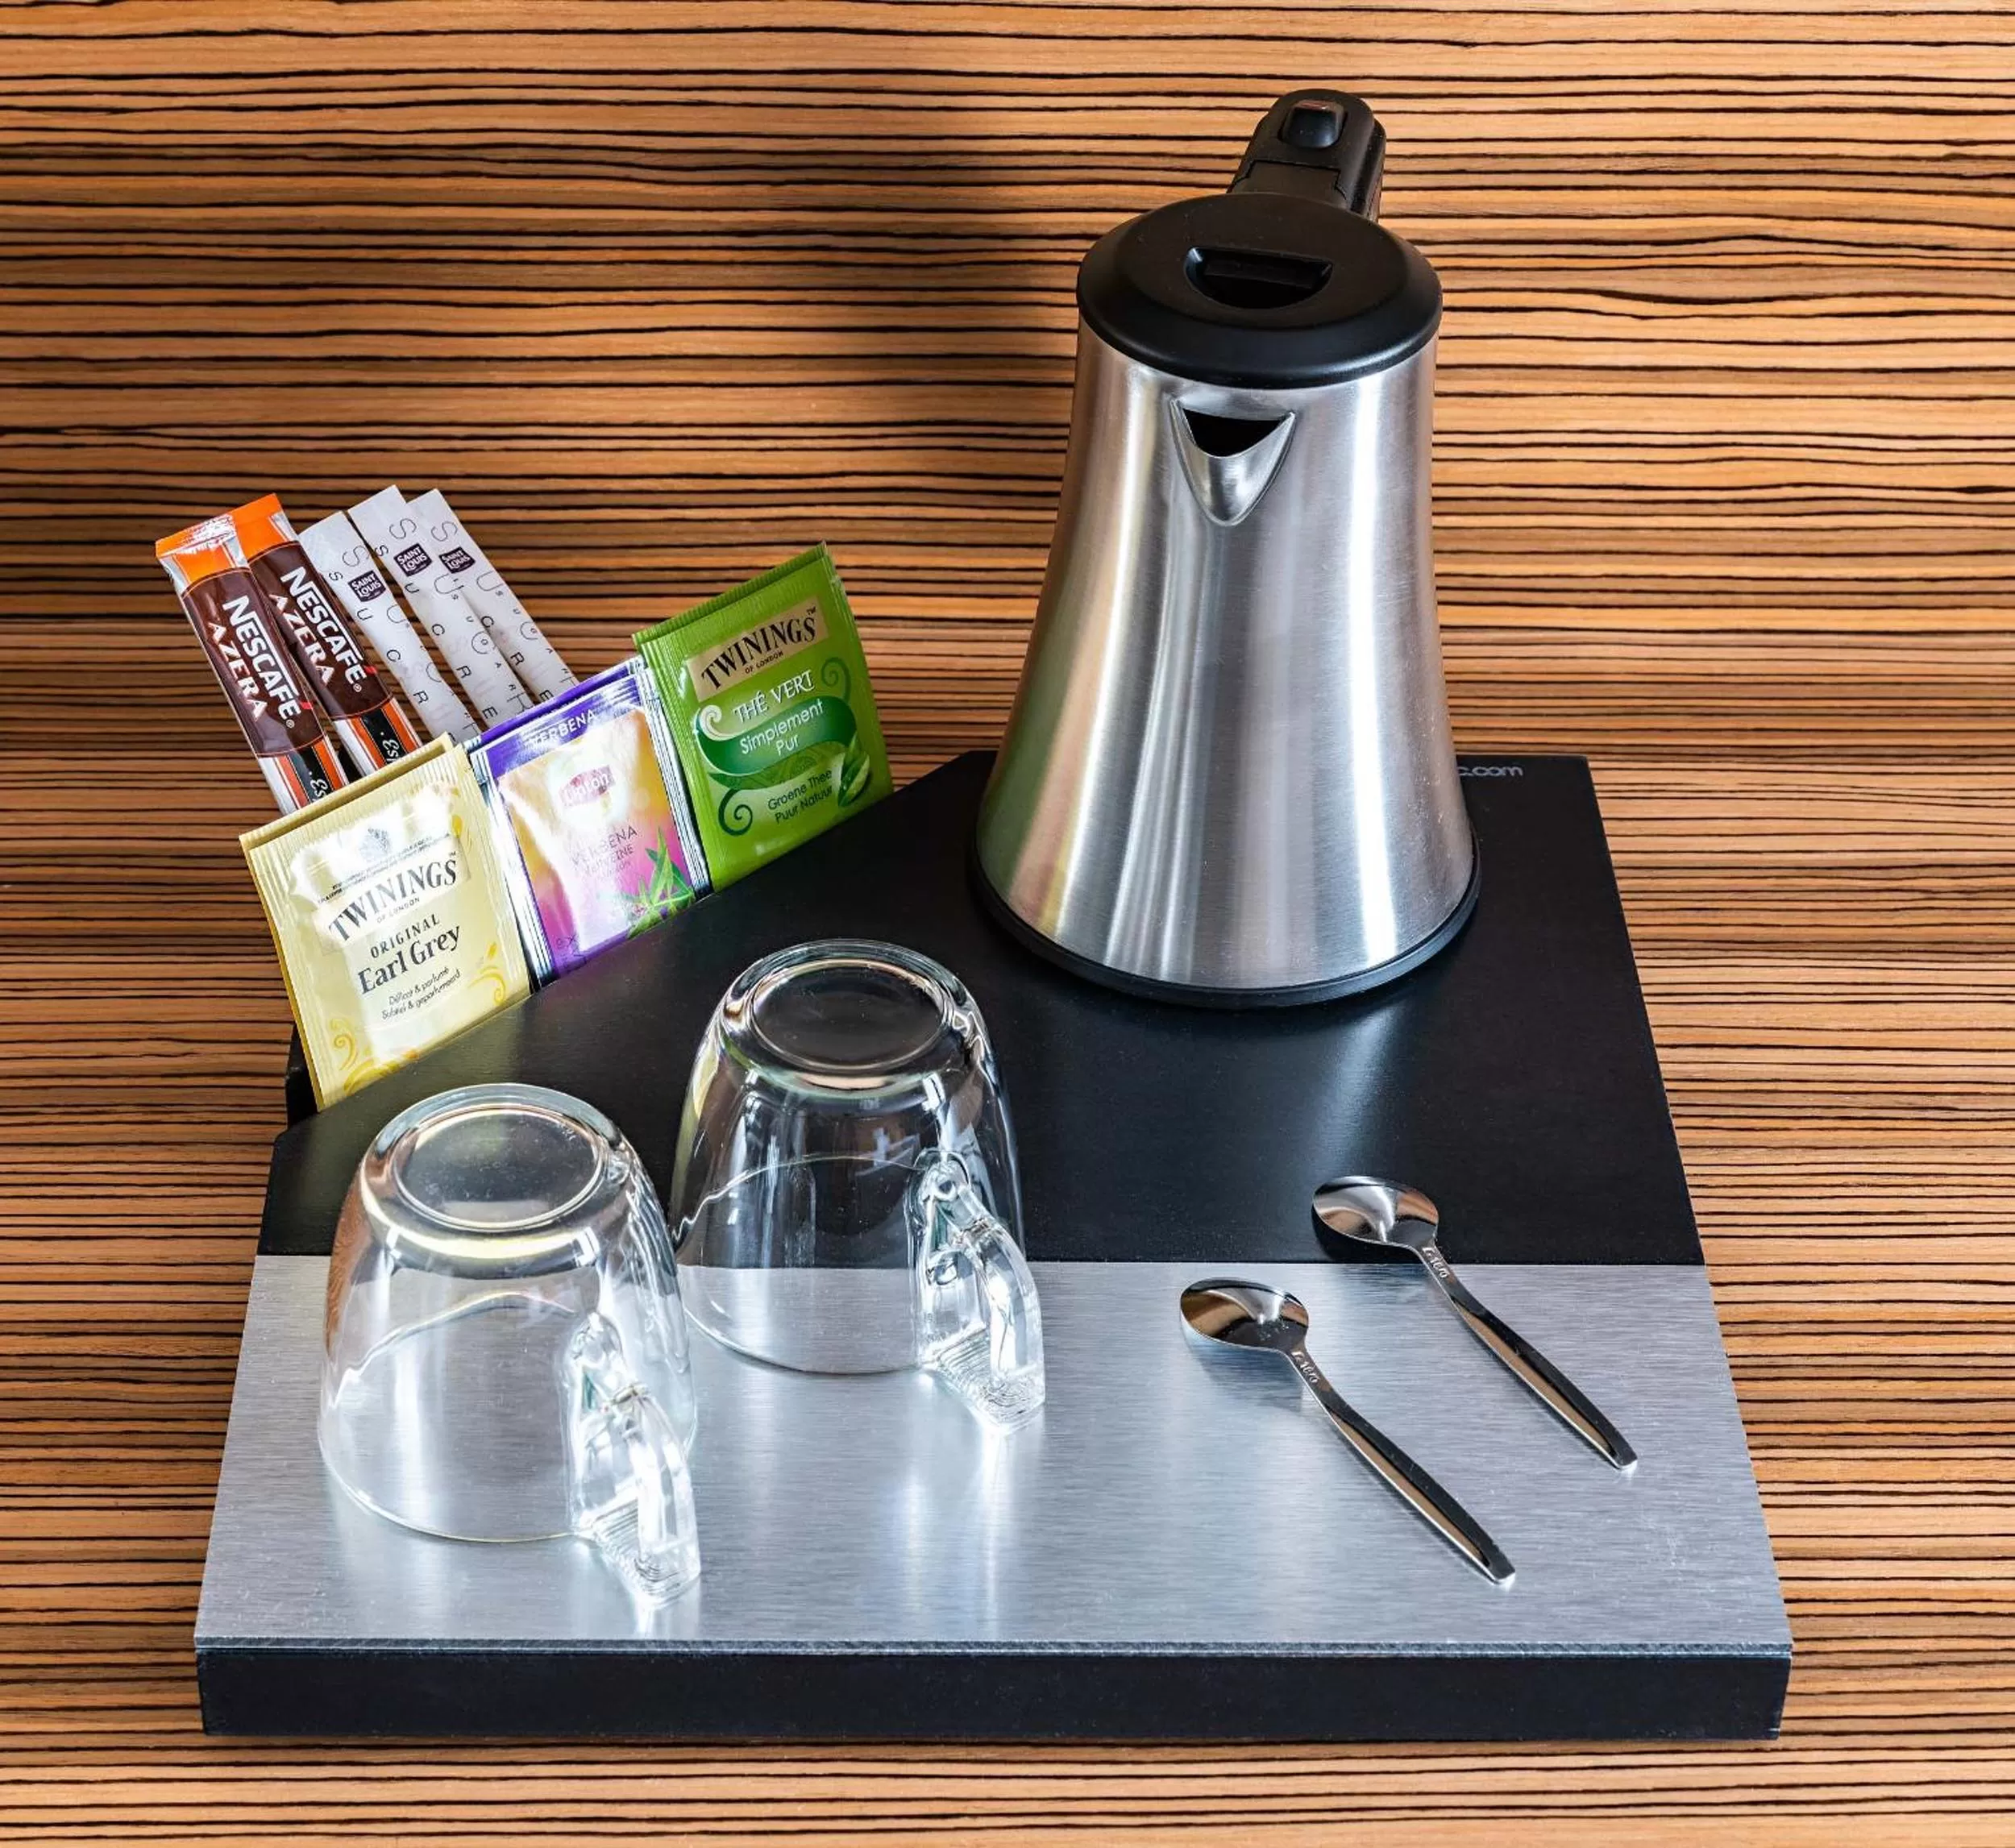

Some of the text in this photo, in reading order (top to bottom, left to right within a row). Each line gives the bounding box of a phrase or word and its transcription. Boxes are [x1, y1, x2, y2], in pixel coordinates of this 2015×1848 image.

[397, 546, 422, 563] SAINT
[404, 554, 428, 571] LOUIS
[447, 556, 471, 570] LOUIS
[351, 573, 376, 590] SAINT
[356, 582, 382, 598] LOUIS
[269, 594, 334, 685] AZERA
[701, 617, 816, 690] TWININGS
[209, 622, 268, 723] AZERA
[745, 651, 783, 675] OF LONDON
[733, 670, 816, 723] THÉ VERT
[740, 698, 824, 754] Simplement
[775, 734, 800, 756] Pur
[768, 769, 833, 810] Groene Thee
[1457, 766, 1523, 777] c.com
[775, 785, 833, 824] Puur Natuur
[328, 859, 457, 941] TWININGS
[370, 913, 440, 958] ORIGINAL
[358, 925, 460, 995] Earl Grey
